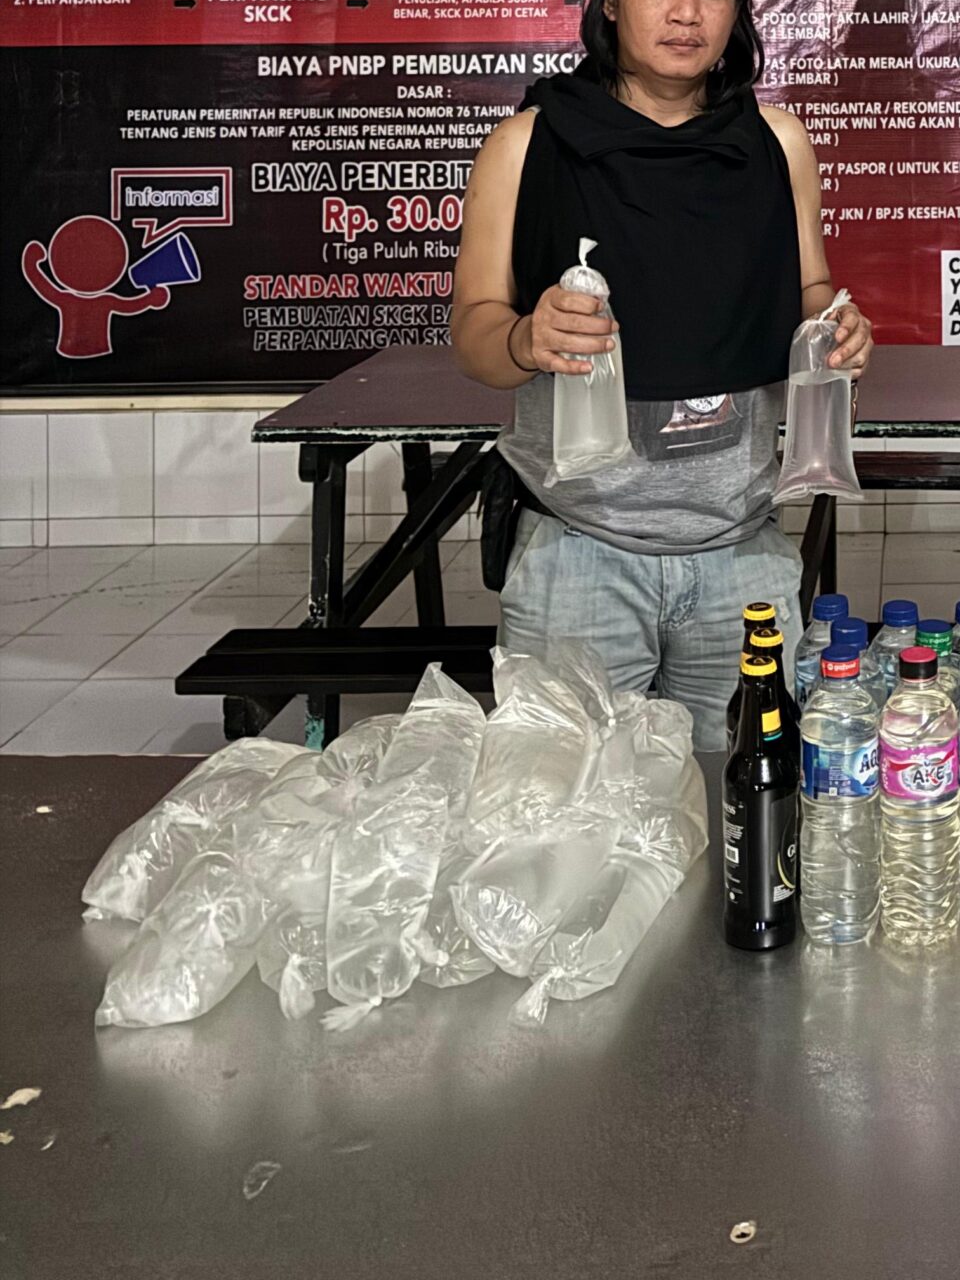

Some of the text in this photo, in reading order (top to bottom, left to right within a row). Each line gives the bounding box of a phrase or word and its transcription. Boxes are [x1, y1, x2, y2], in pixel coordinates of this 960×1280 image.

[245, 6, 291, 22] SKCK
[258, 56, 322, 76] BIAYA
[329, 56, 385, 75] PNBP
[393, 54, 525, 74] PEMBUATAN
[252, 162, 337, 192] BIAYA
[126, 186, 219, 206] informasi
[323, 197, 379, 242] Rp.
[333, 241, 367, 264] Tiga
[374, 241, 418, 258] Puluh
[425, 241, 460, 259] Ribu
[244, 272, 452, 300] STANDAR WAKTU
[913, 765, 945, 785] AKE
